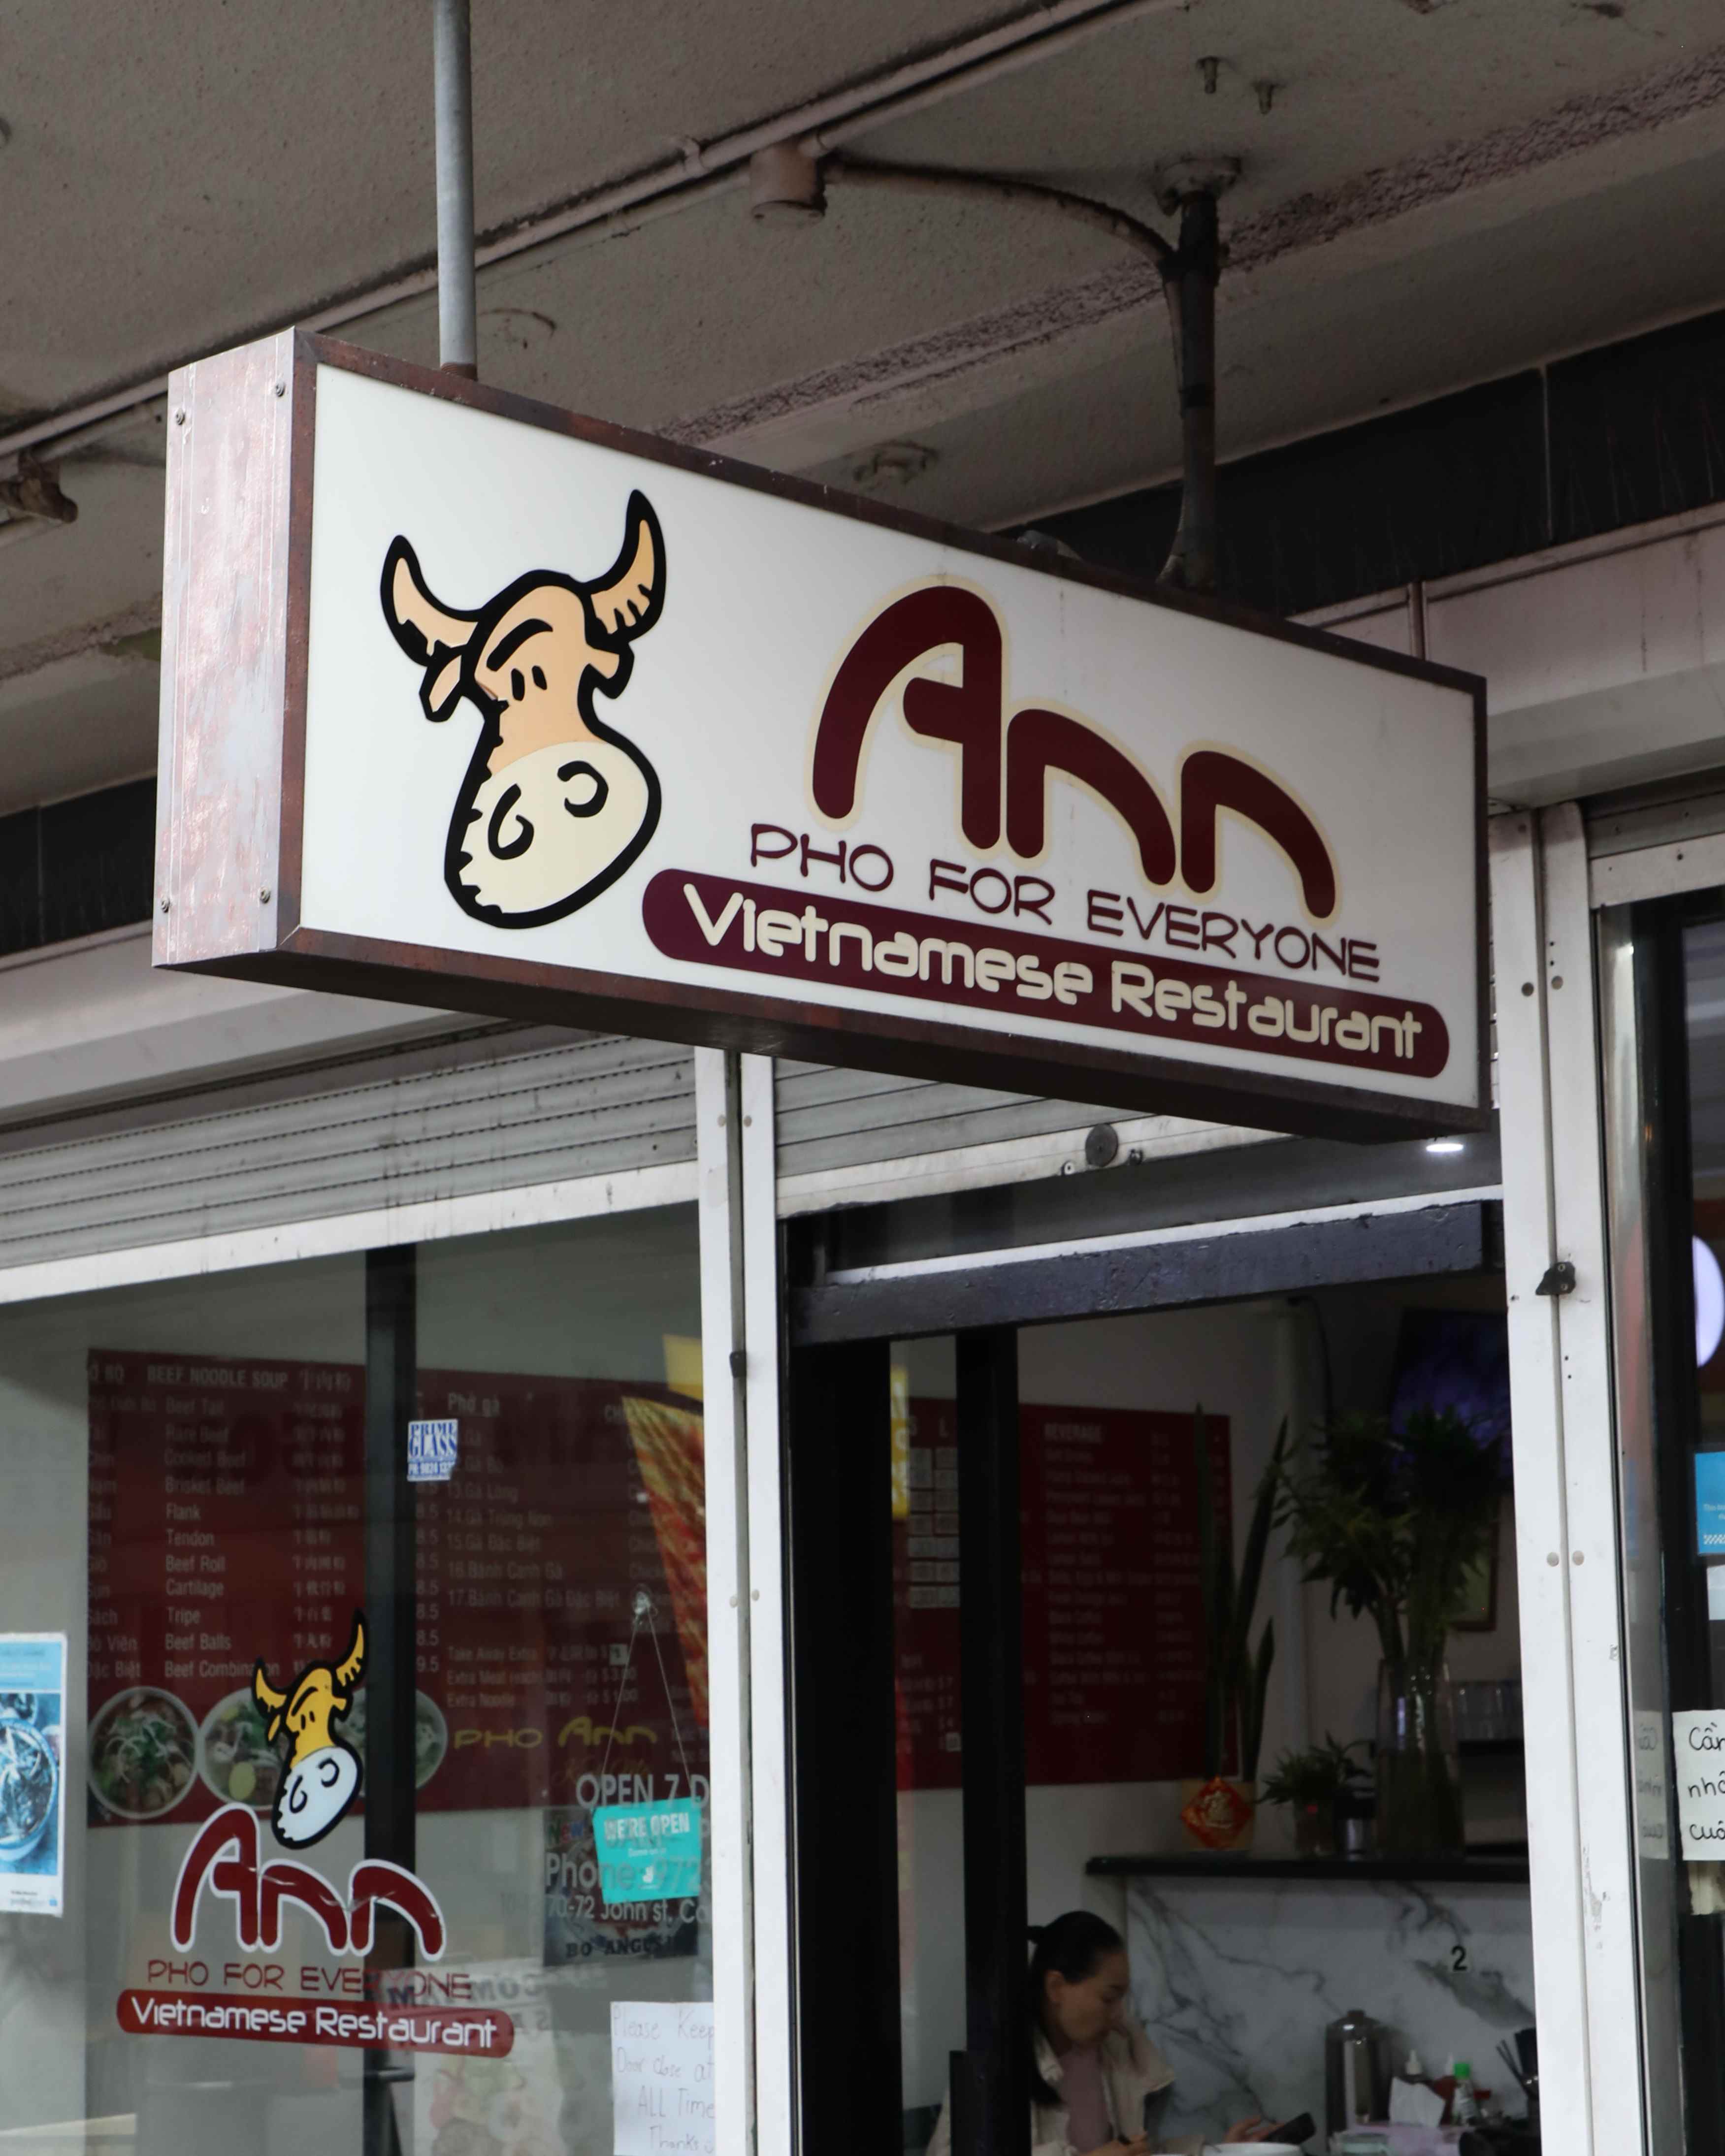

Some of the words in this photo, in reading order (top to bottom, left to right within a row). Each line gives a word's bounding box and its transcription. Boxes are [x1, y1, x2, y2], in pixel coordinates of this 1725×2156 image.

[809, 580, 1339, 925] Ann
[750, 824, 894, 893] PHO
[929, 860, 1056, 924] FOR
[1087, 890, 1381, 982] EVERYONE
[682, 883, 1095, 1006] Vietnamese
[1111, 960, 1424, 1060] Restaurant
[252, 1372, 289, 1389] SOUP
[411, 1422, 456, 1436] PRIME
[409, 1435, 458, 1457] GLASS
[165, 1502, 201, 1521] Flank
[165, 1528, 215, 1547] Tendon
[165, 1554, 195, 1573] Beef
[200, 1555, 227, 1574] Roll
[165, 1578, 225, 1599] Cartilage
[167, 1607, 202, 1626] Tripe
[165, 1633, 195, 1651] Beef
[199, 1633, 232, 1652] Balls
[164, 1660, 195, 1679] Beef
[453, 1727, 544, 1750] PHO
[576, 1773, 654, 1809] OPEN
[664, 1773, 680, 1808] 7
[650, 1812, 690, 1836] OPEN
[170, 1802, 446, 1962] Ann
[1451, 1945, 1468, 1972] 2
[148, 1959, 209, 1986] PHO
[224, 1963, 284, 1991] FOR
[131, 1996, 307, 2033] Vietnamese
[315, 2006, 497, 2048] Restaurant
[613, 2004, 661, 2040] Please
